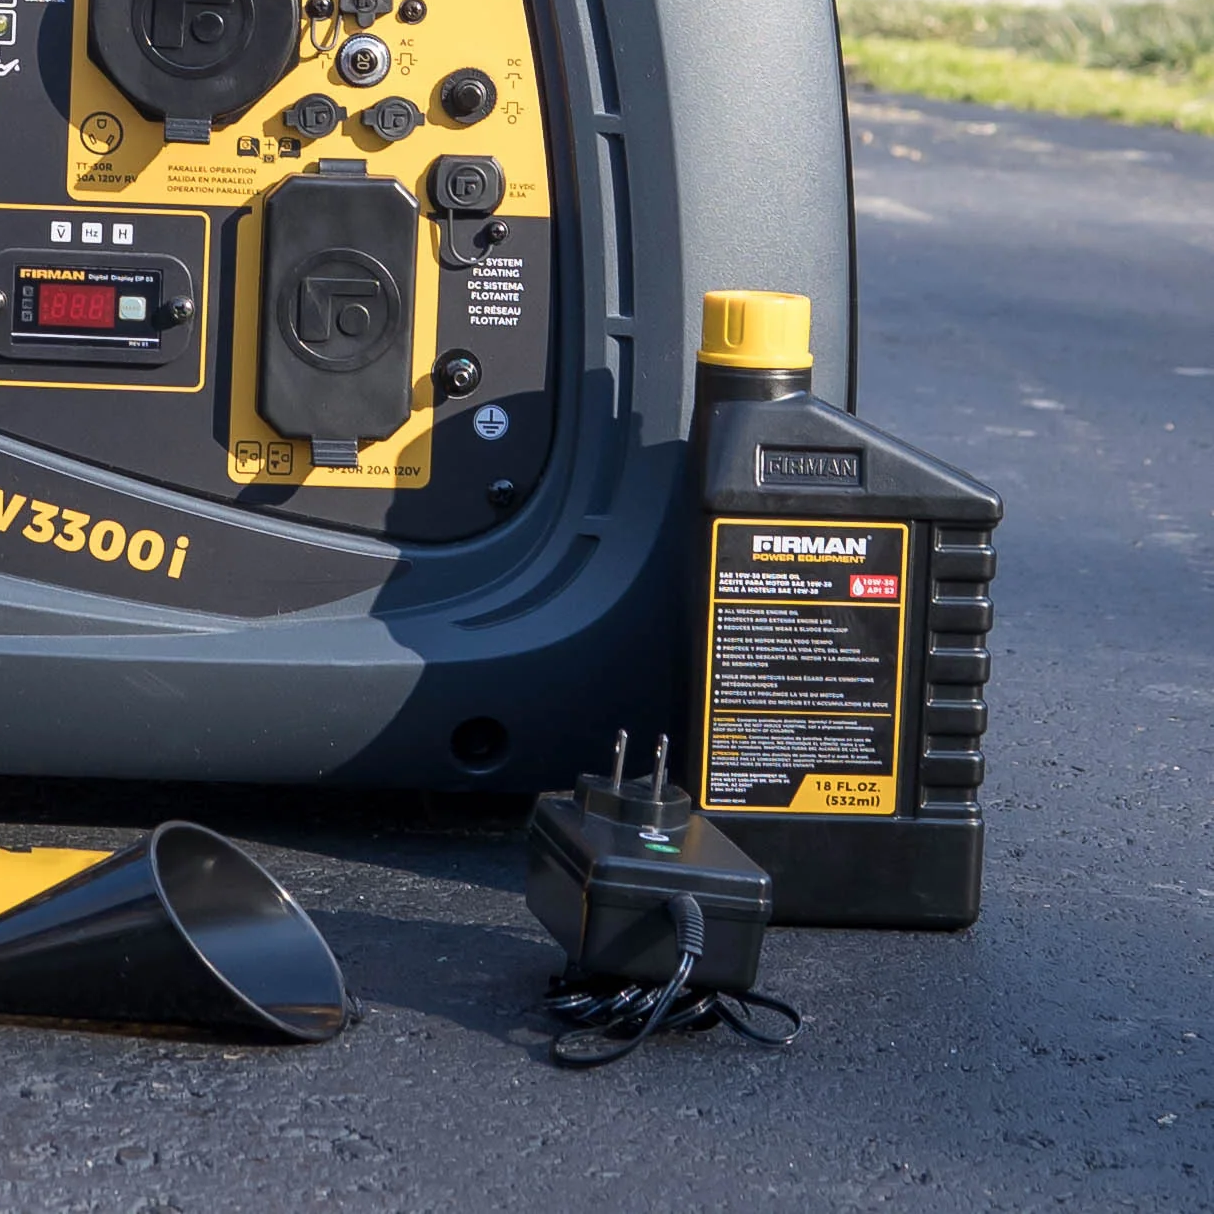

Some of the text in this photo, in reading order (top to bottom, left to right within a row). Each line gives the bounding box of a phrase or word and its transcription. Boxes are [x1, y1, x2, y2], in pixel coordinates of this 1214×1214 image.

[399, 38, 414, 47] AC
[356, 54, 371, 70] 20
[507, 58, 522, 67] DC
[76, 161, 113, 172] TT-30R
[167, 164, 258, 175] PARALLEL OPERATION
[76, 173, 96, 183] 30A
[97, 173, 123, 183] 120V
[167, 175, 254, 185] SALIDA EN PARALELO
[85, 227, 99, 238] Hz
[118, 228, 127, 240] H
[486, 257, 523, 268] SYSTEM
[19, 268, 86, 281] FIRMAN
[88, 274, 109, 282] Digital
[472, 267, 520, 278] FLOATING
[467, 280, 524, 291] DC SISTEMA
[470, 291, 520, 302] FLOTANTE
[468, 304, 522, 316] DC RÉSEAU
[470, 316, 519, 326] FLOTTANT
[366, 465, 390, 475] 20A
[393, 466, 422, 477] 120V
[766, 457, 858, 477] FIRMAN
[752, 534, 867, 555] FIRMAN
[752, 553, 867, 564] POWER EQUIPMENT
[815, 780, 881, 793] 18 FL.OZ.
[825, 794, 881, 808] (532ml)
